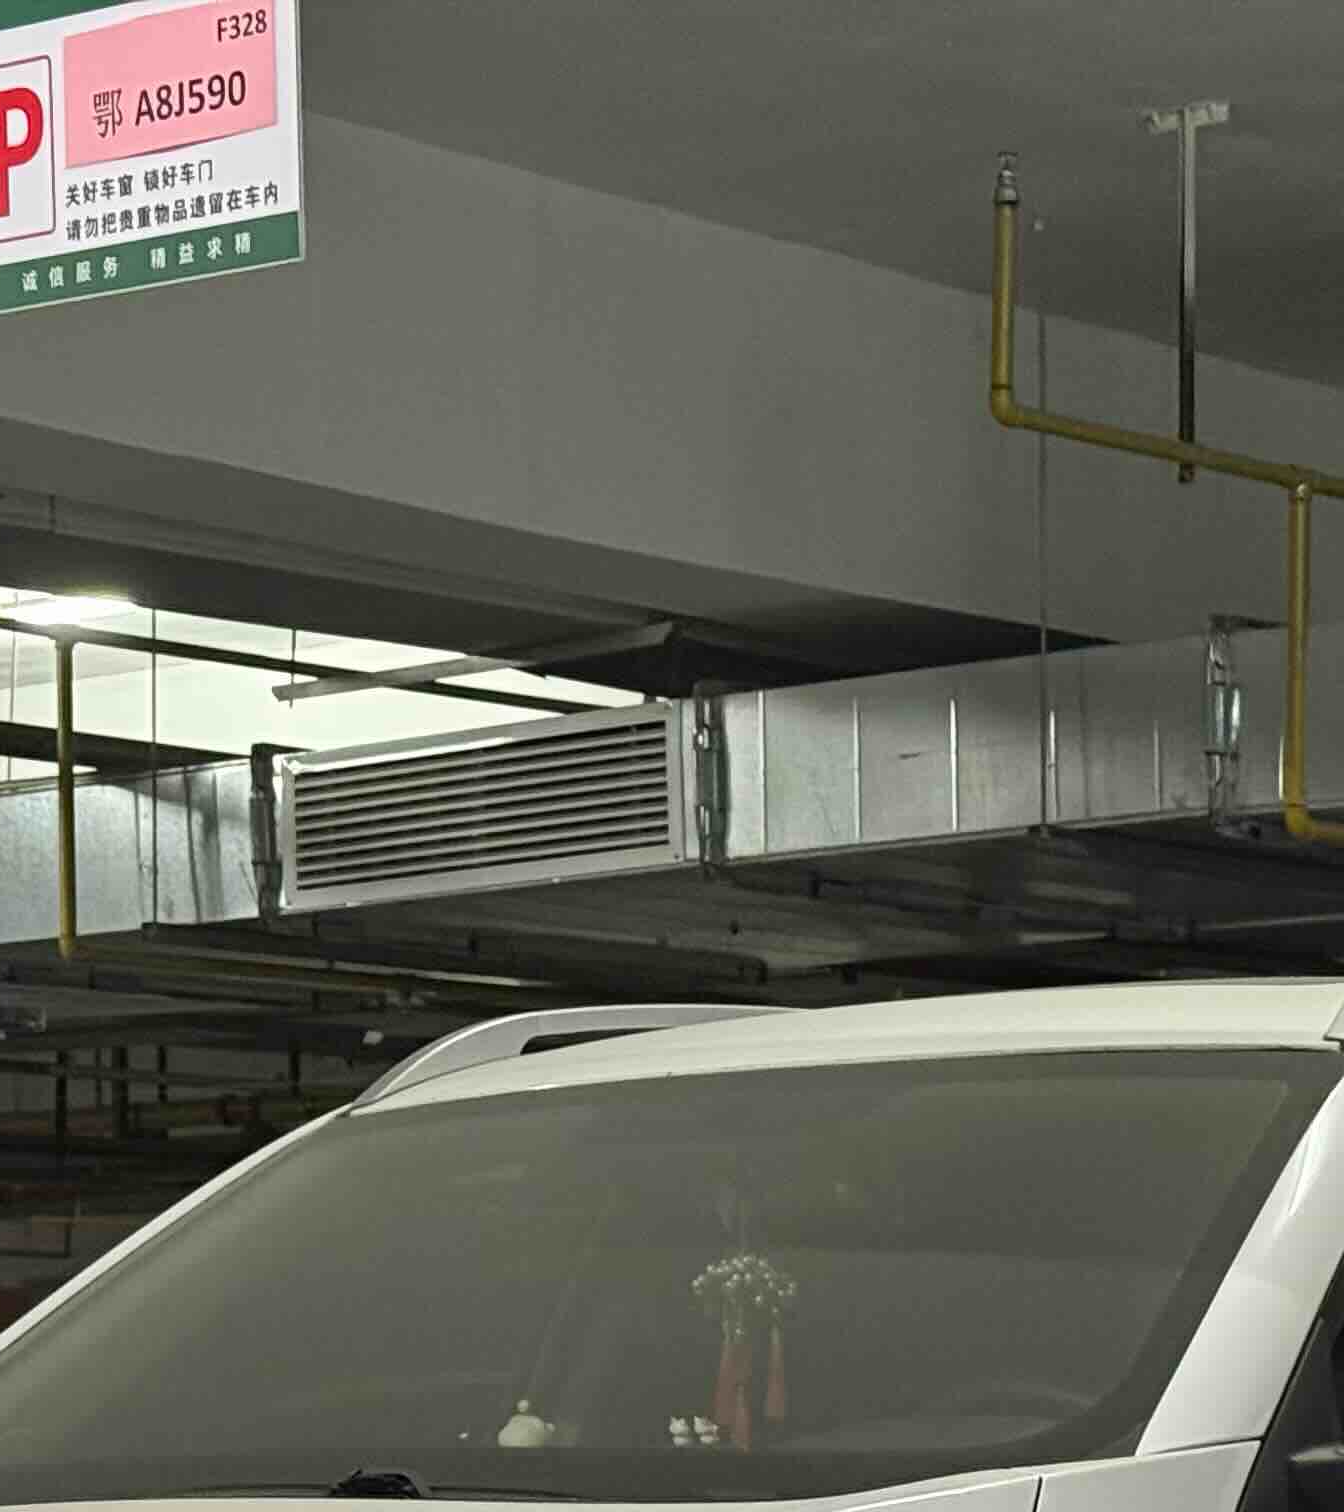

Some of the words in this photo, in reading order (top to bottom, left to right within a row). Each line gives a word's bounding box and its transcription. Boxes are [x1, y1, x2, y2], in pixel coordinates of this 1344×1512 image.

[217, 9, 267, 42] F328
[93, 88, 124, 138] 鄂
[135, 71, 246, 126] A8J590
[65, 174, 134, 208] 关好车窗
[144, 159, 214, 192] 锁好车门
[66, 181, 279, 241] 请勿把贵重物品遗留在车内
[21, 257, 120, 292] 诚信服务
[150, 231, 252, 270] 精益求精
